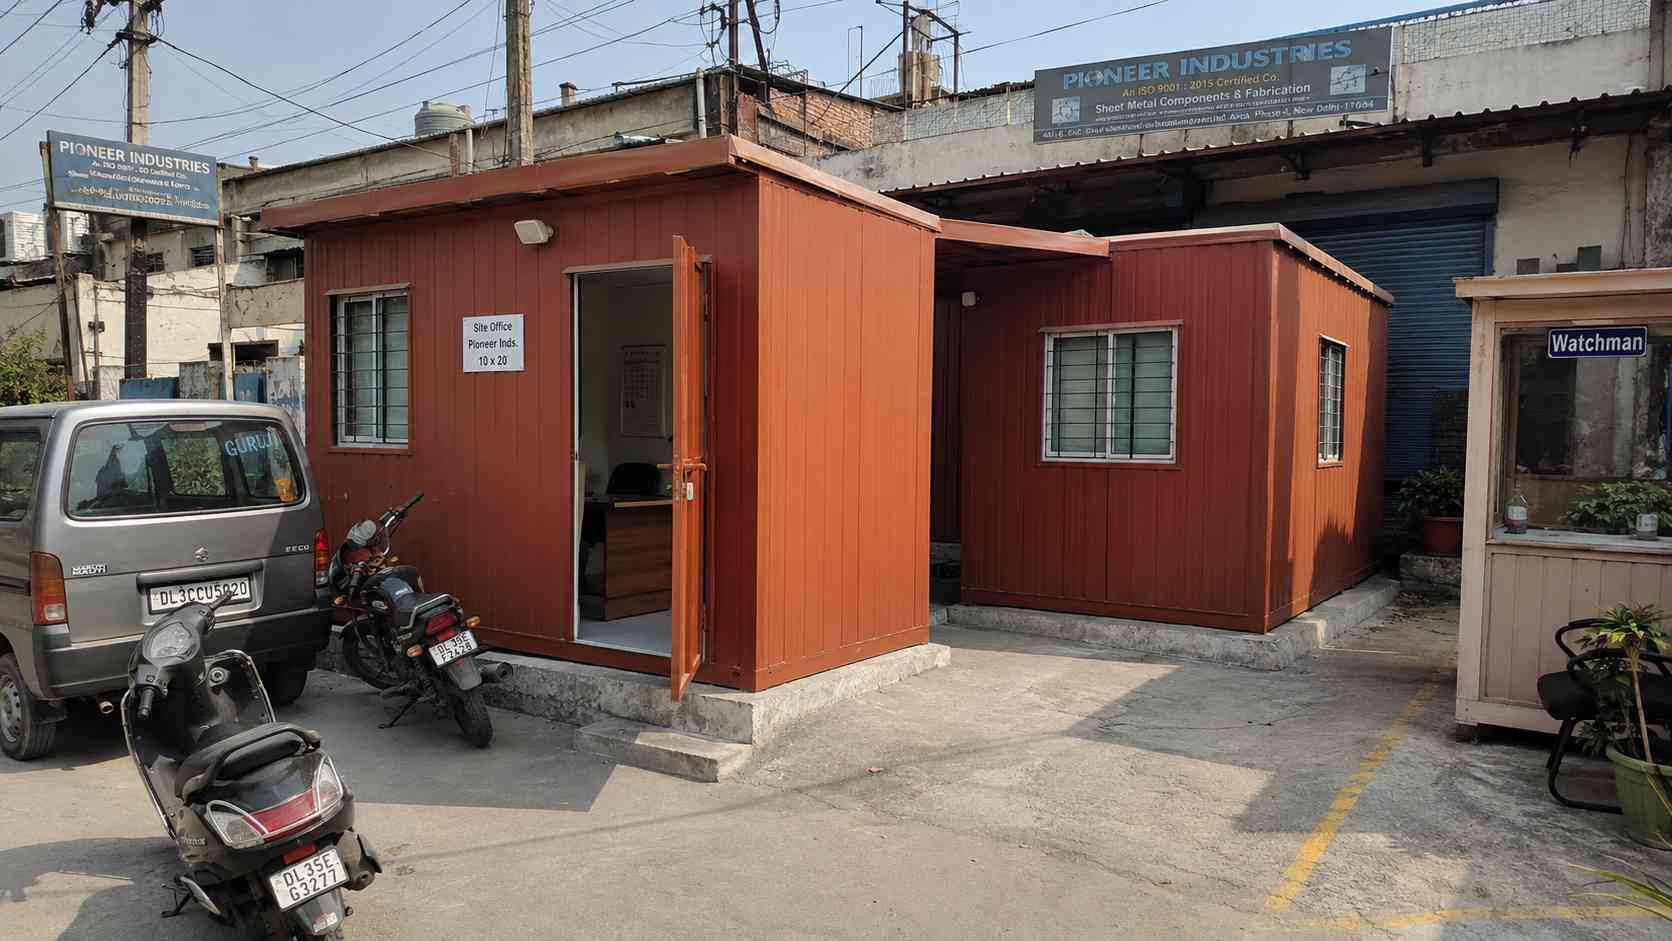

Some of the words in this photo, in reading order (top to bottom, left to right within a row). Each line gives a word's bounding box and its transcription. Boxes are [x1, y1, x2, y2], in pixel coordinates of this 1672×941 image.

[1063, 60, 1171, 90] PIONEER
[1179, 39, 1352, 76] INDUSTRIES
[1138, 85, 1154, 96] ISO
[1157, 83, 1180, 94] 9001
[1190, 79, 1215, 90] 2015
[1095, 101, 1124, 115] Sheet
[1127, 97, 1157, 110] Metal
[1160, 91, 1231, 108] Components
[1245, 83, 1311, 98] Fabrication
[59, 140, 125, 162] PIONEER
[130, 150, 210, 175] INDUSTRIES
[473, 321, 489, 333] Site
[490, 321, 513, 332] Office
[468, 339, 497, 349] Pioneer
[499, 337, 519, 348] Inds.
[1551, 333, 1643, 353] Watchman
[479, 355, 489, 366] 10
[490, 357, 496, 365] x
[497, 355, 508, 365] 20
[289, 869, 337, 902] G3277
